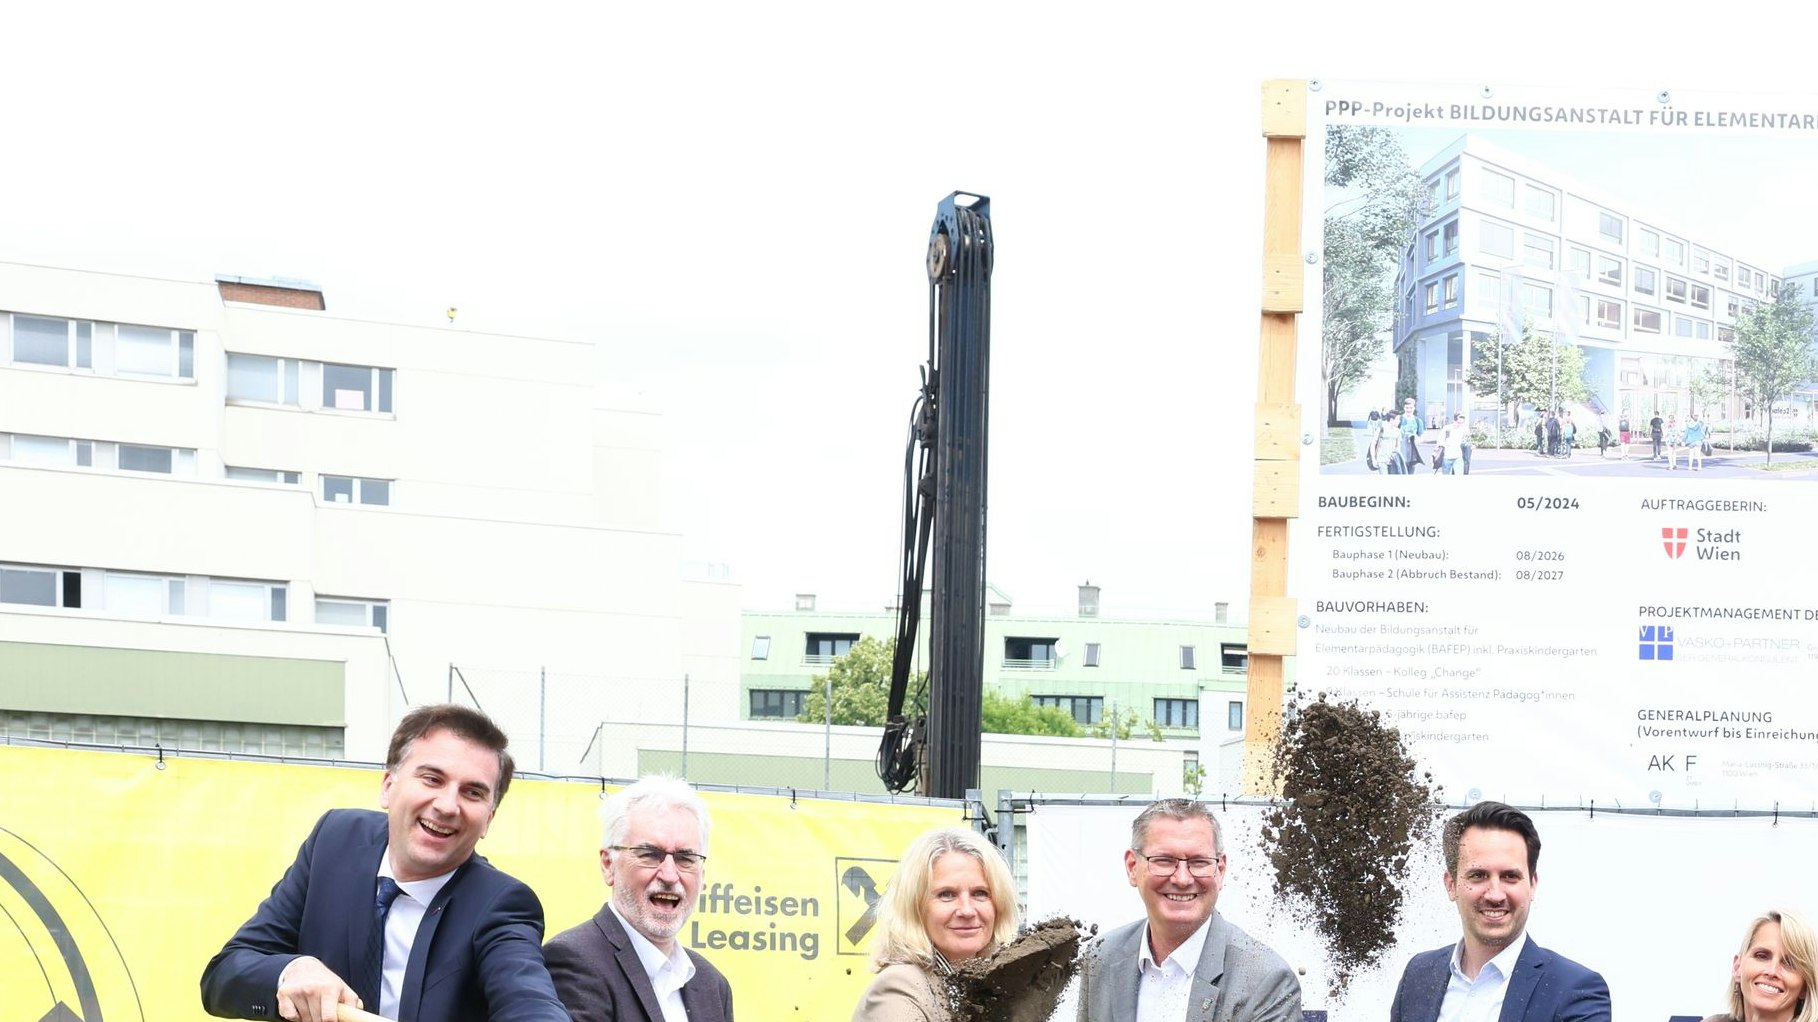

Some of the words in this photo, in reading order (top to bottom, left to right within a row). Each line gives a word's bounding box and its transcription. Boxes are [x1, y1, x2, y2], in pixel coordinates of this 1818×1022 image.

[1326, 100, 1443, 122] PPP-Projekt
[1450, 105, 1644, 125] BILDUNGSANSTALT
[1650, 106, 1687, 126] FÜR
[1319, 496, 1410, 508] BAUBEGINN:
[1517, 496, 1579, 511] 05/2024
[1641, 499, 1766, 512] AUFTRAGGEBERIN:
[1318, 526, 1440, 537] FERTIGSTELLUNG:
[1697, 528, 1741, 543] Stadt
[1333, 549, 1384, 561] Bauphase
[1395, 549, 1448, 561] (Neubau):
[1516, 551, 1564, 561] 08/2026
[1697, 546, 1740, 560] Wien
[1333, 569, 1384, 580] Bauphase
[1388, 569, 1393, 578] 2
[1397, 569, 1446, 580] (Abbruch
[1450, 570, 1501, 581] Bestand):
[1516, 570, 1563, 581] 08/2027
[1317, 601, 1428, 613] BAUVORHABEN:
[1640, 606, 1801, 620] PROJEKTMANAGEMENT
[1316, 624, 1357, 636] Neubau
[1359, 624, 1377, 634] der
[1380, 624, 1461, 640] Bildungsanstalt
[1464, 625, 1478, 635] für
[1316, 643, 1424, 656] Elementarpädagogik
[1428, 644, 1470, 655] (BAFEP)
[1473, 645, 1494, 654] inkl.
[1497, 645, 1597, 658] Praxiskindergarten
[1343, 666, 1382, 676] Klassen
[1393, 667, 1428, 680] Kolleg
[1387, 688, 1421, 699] Schule
[1424, 688, 1438, 699] für
[1442, 689, 1490, 700] Assistenz
[1638, 710, 1771, 723] GENERALPLANUNG
[1638, 725, 1719, 738] (Vorentwurf
[1723, 727, 1741, 738] bis
[1648, 755, 1674, 771] AK
[1686, 755, 1697, 771] F
[700, 883, 820, 917] iffeisen
[691, 921, 820, 961] Leasing
